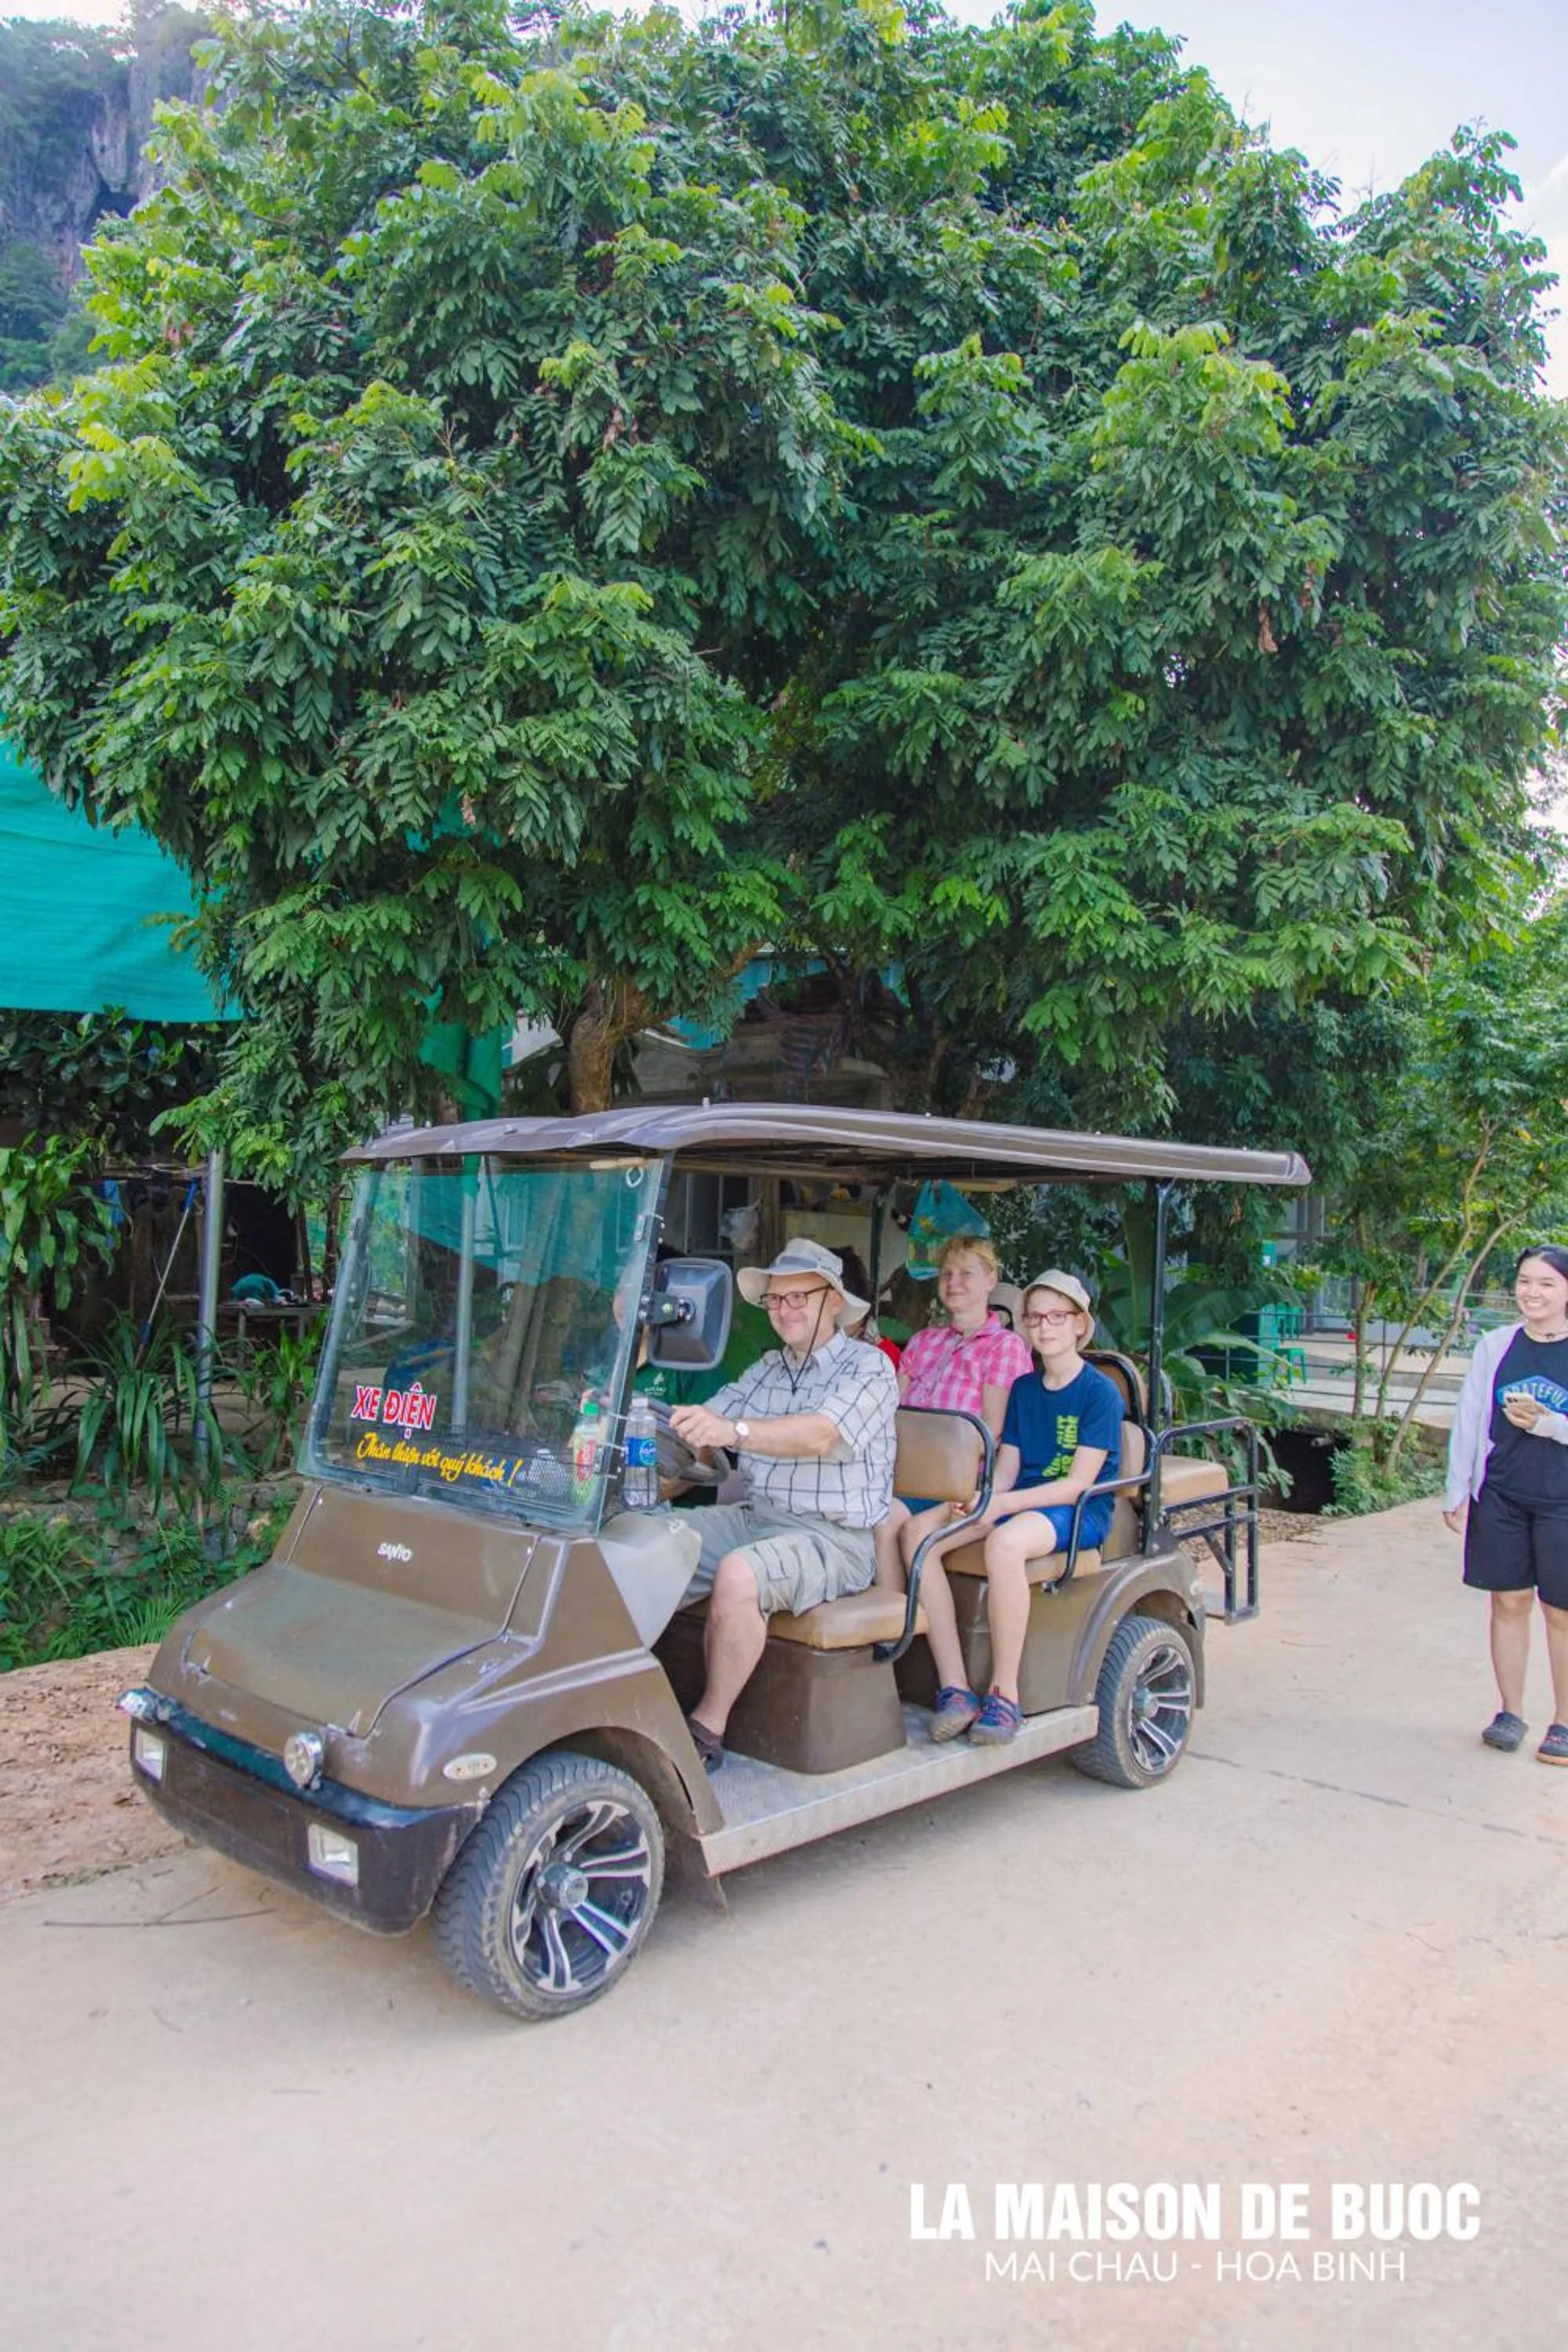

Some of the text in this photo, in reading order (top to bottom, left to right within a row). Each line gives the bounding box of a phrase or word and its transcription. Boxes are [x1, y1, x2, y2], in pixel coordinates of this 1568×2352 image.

[351, 1382, 437, 1439] XE ĐIỆN
[440, 1452, 467, 1482] quý
[464, 1452, 505, 1481] khách
